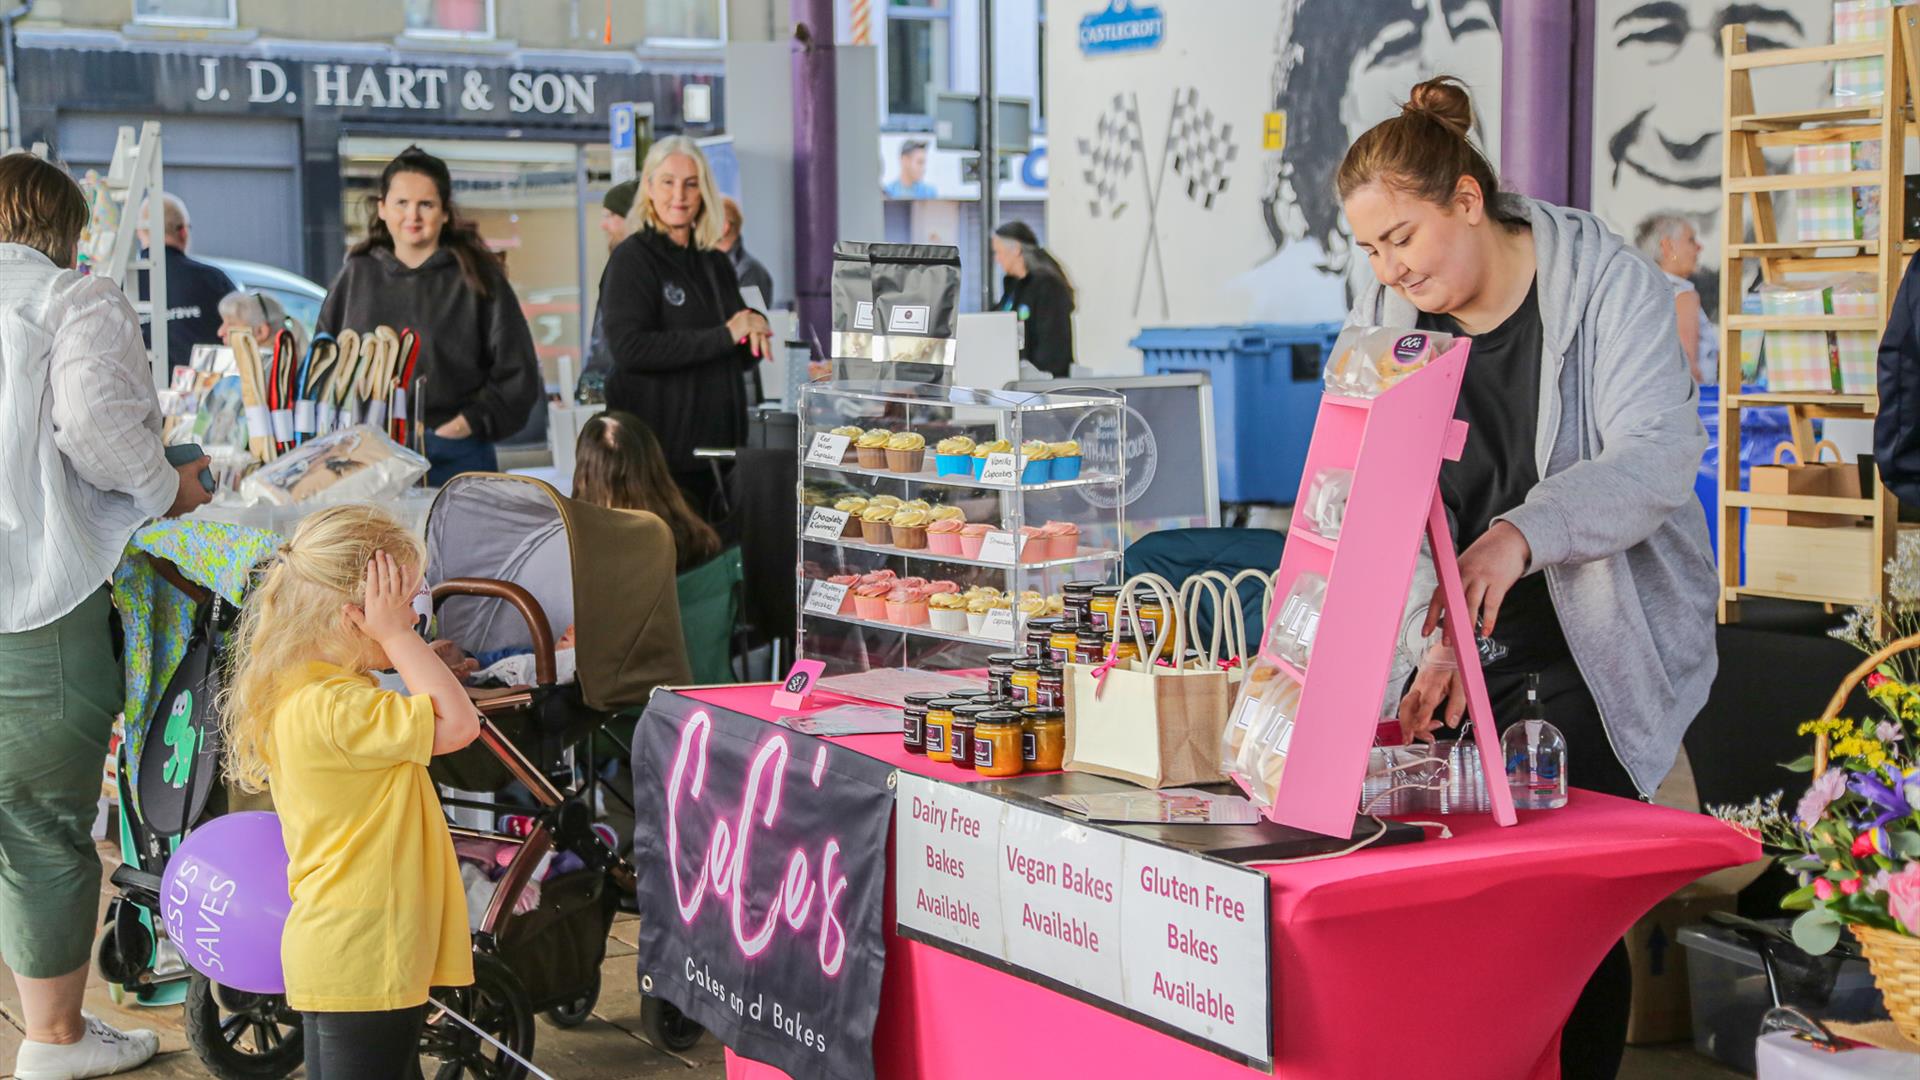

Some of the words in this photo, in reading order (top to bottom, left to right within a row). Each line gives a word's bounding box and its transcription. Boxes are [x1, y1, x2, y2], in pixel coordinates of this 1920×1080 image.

[1081, 19, 1161, 43] CASTLECROFT
[196, 58, 230, 101] J.
[246, 61, 297, 104] D.
[313, 64, 448, 109] HART
[461, 70, 494, 111] &
[508, 72, 597, 114] SON
[614, 108, 631, 148] P
[812, 511, 843, 525] Chocolate
[667, 709, 849, 977] CeCe's
[912, 796, 947, 833] Dairy
[950, 807, 980, 838] Free
[926, 845, 965, 879] Bakes
[1006, 844, 1057, 885] Vegan
[1062, 862, 1113, 903] Bakes
[167, 860, 199, 957] JESUS
[916, 888, 980, 930] Available
[1140, 865, 1199, 908] Gluten
[1205, 885, 1245, 922] Free
[195, 875, 237, 972] SAVES
[1022, 903, 1099, 953] Available
[1167, 923, 1218, 965] Bakes
[685, 956, 726, 1002] Cakes
[730, 993, 763, 1022] and
[773, 1002, 826, 1053] Bakes
[1153, 971, 1235, 1025] Available
